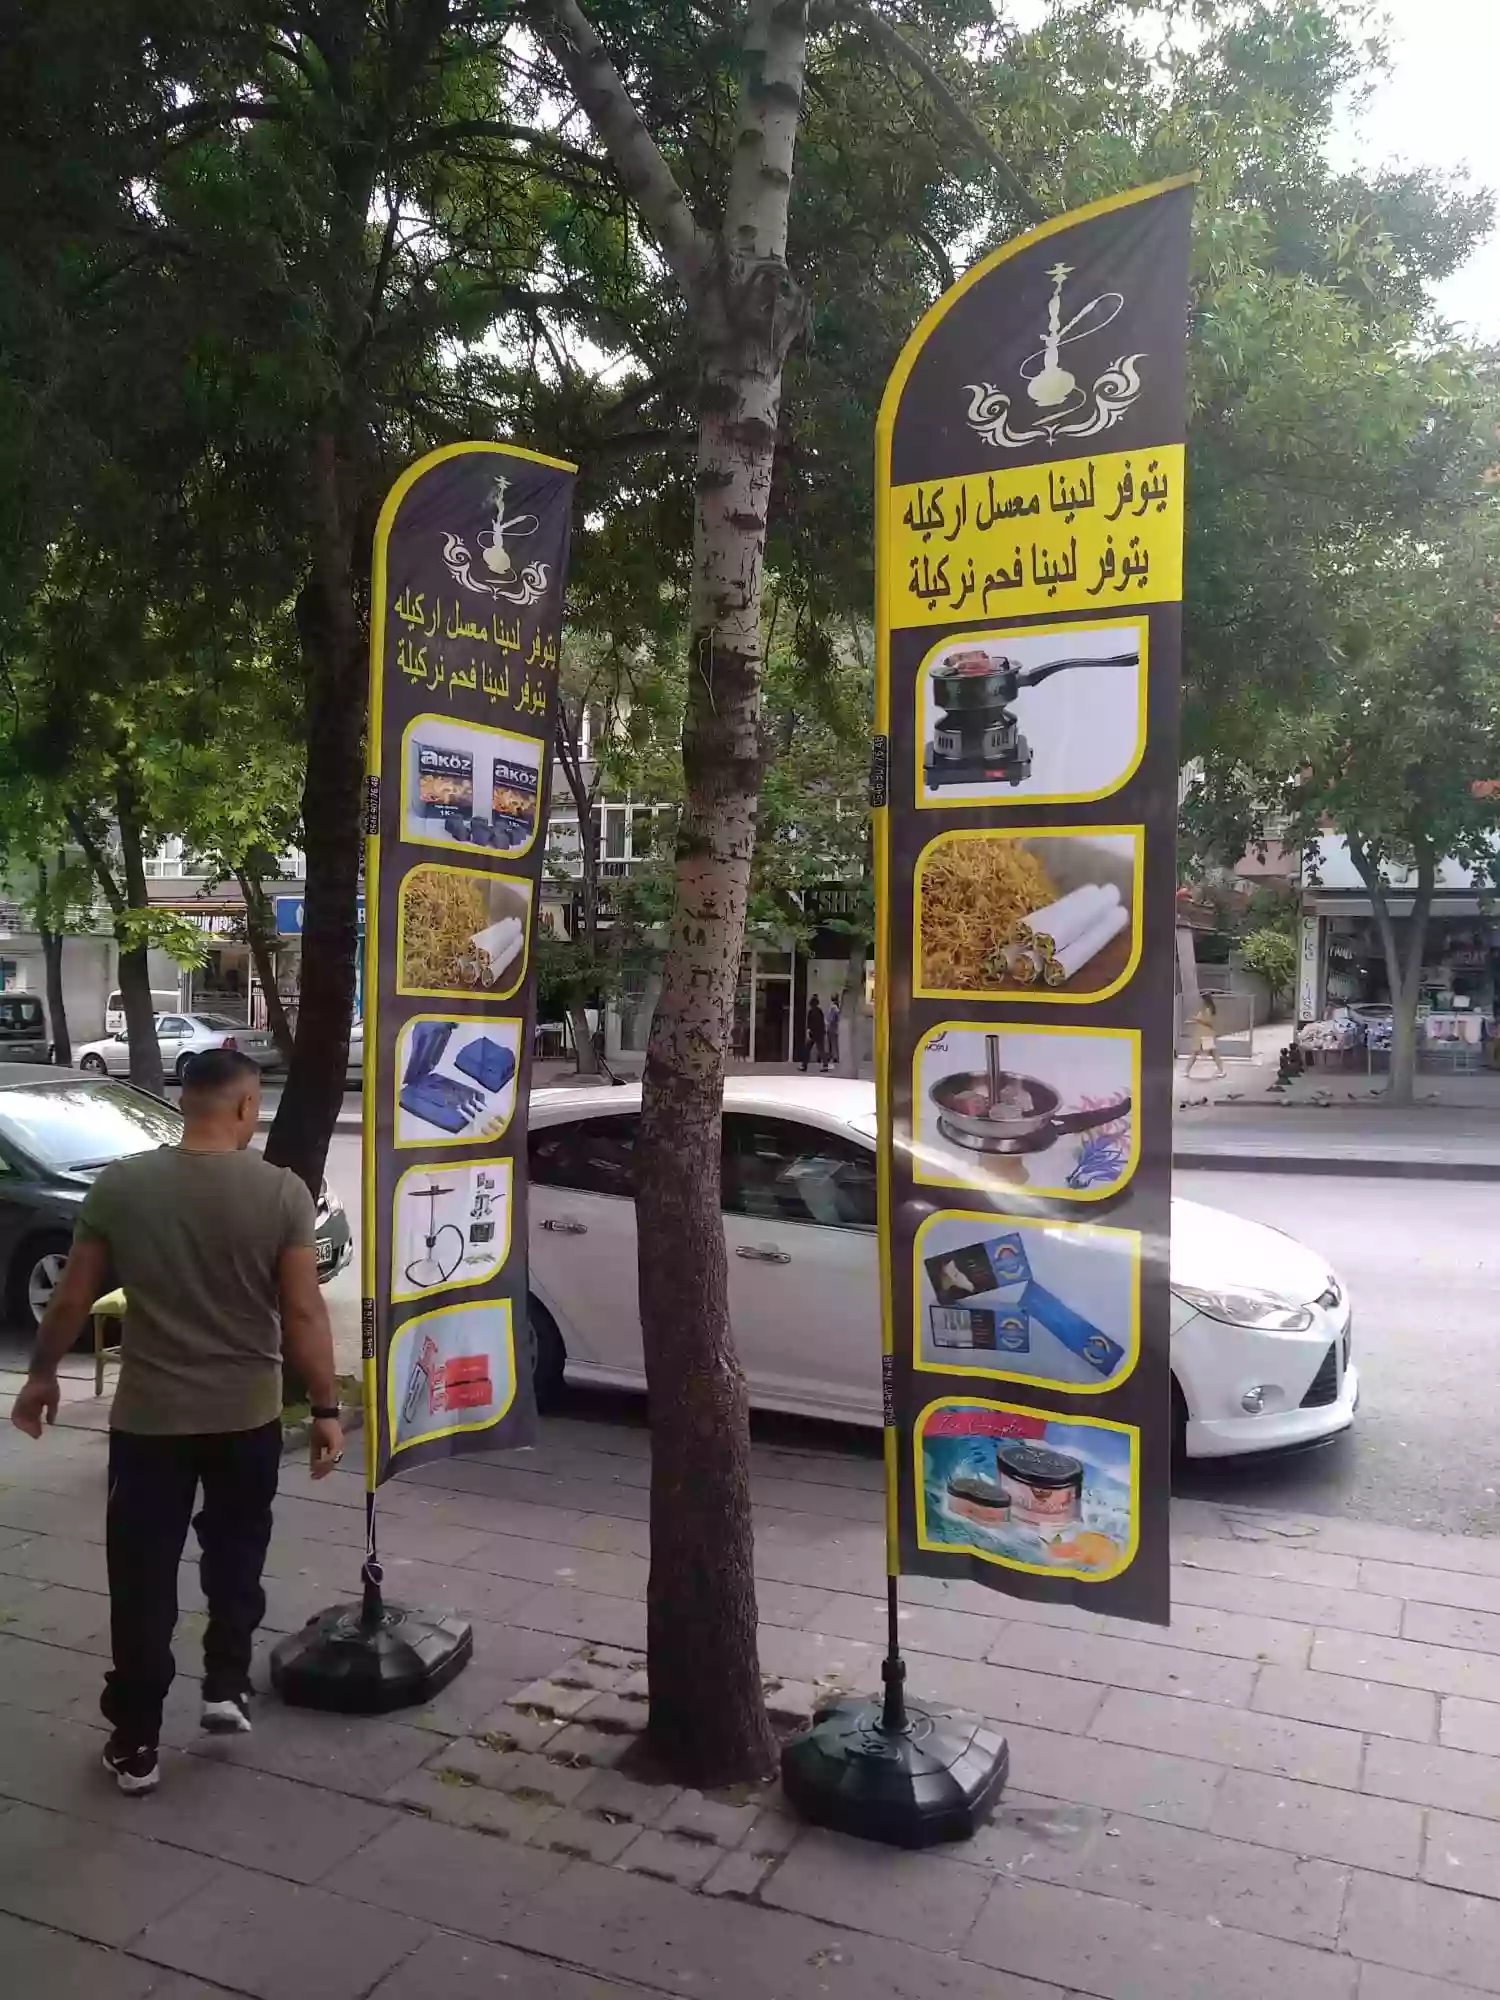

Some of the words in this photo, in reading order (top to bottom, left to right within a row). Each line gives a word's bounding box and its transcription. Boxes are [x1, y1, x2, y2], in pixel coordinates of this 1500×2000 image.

[976, 476, 1040, 531] معسل
[1049, 461, 1096, 524] لدينا
[1104, 459, 1168, 521] يتوفر
[981, 546, 1023, 614] فحم
[1031, 536, 1077, 597] لدينا
[1086, 535, 1149, 595] يتوفر
[446, 600, 488, 642] معسل
[492, 613, 521, 656] لدينا
[524, 626, 557, 669] يتوفر
[448, 657, 477, 699] فحم
[481, 659, 510, 704] لدينا
[513, 672, 546, 716] يتوفر
